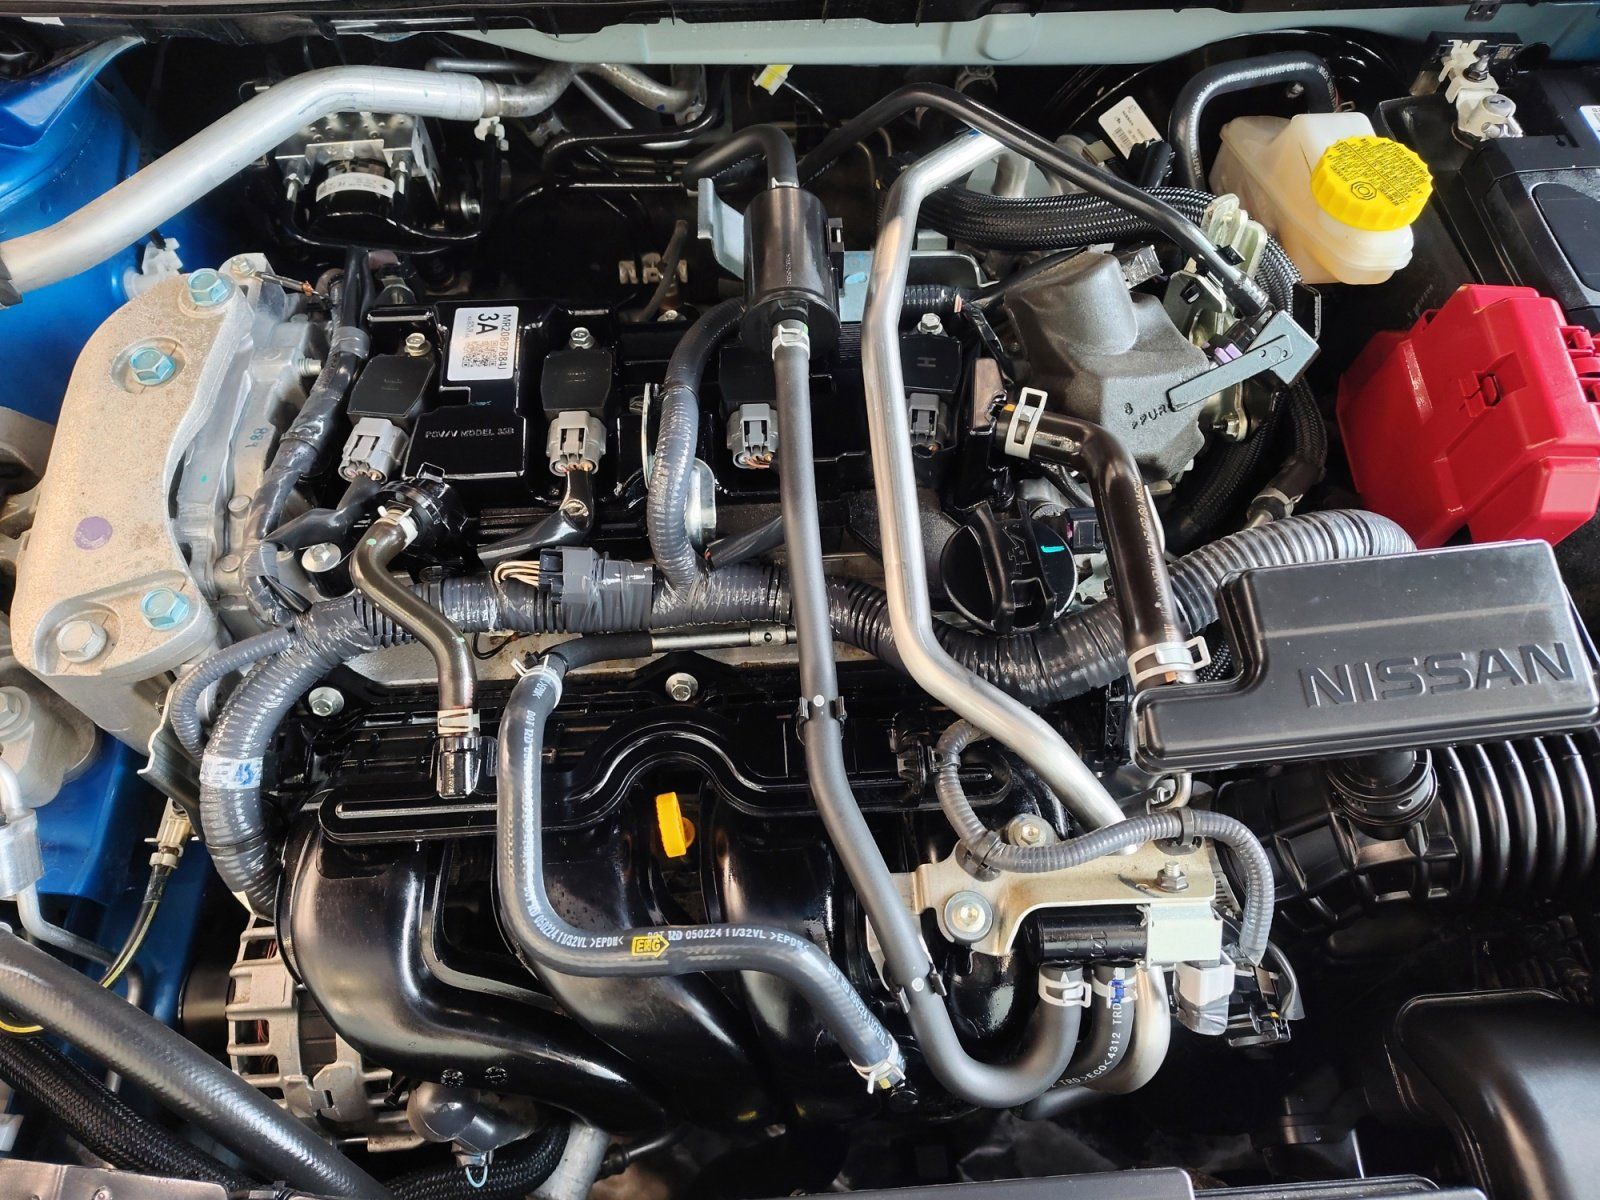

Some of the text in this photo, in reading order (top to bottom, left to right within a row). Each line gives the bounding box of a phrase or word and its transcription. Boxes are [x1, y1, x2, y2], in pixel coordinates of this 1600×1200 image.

[475, 312, 500, 336] 3A
[1299, 641, 1576, 708] NISSAN
[685, 928, 722, 940] 050224
[1112, 1002, 1123, 1025] TRD
